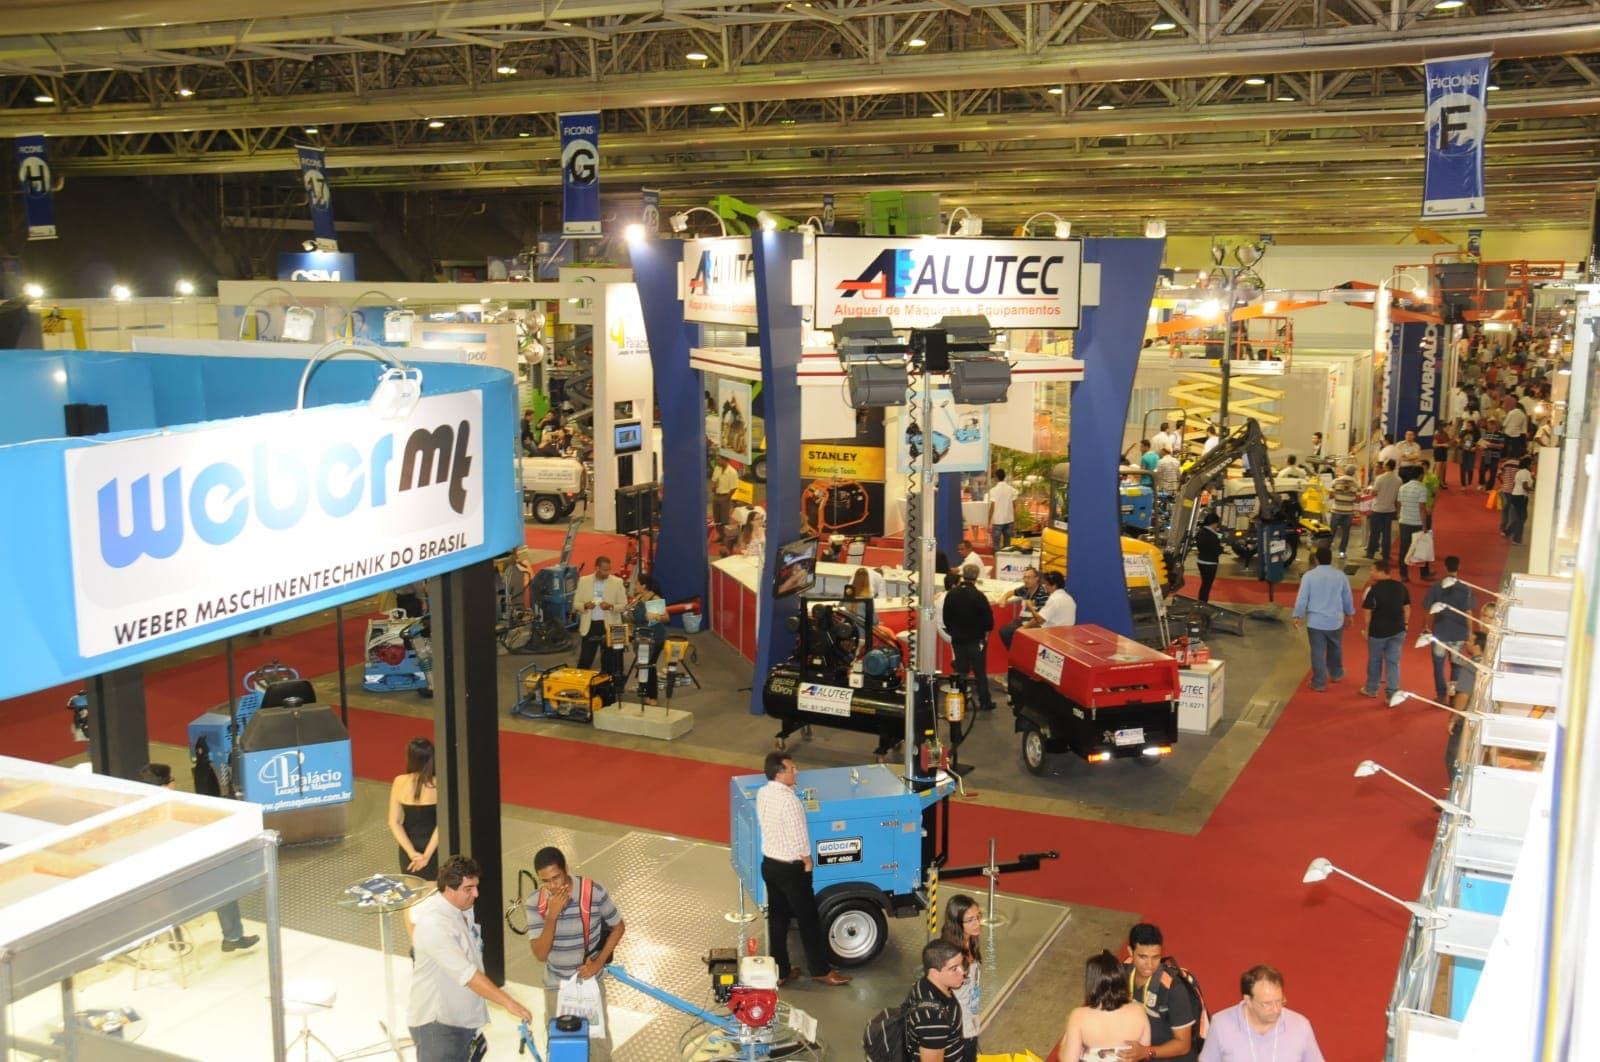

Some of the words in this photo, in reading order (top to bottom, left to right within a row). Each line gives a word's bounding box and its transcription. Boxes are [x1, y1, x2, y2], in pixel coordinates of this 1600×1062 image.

[1430, 74, 1480, 90] FICONS
[564, 126, 593, 136] FICONS
[1440, 105, 1471, 150] F
[571, 149, 595, 183] G
[912, 255, 1064, 294] ALUTEC
[834, 304, 884, 317] Aluguel
[886, 304, 900, 316] de
[977, 304, 1061, 317] Equipamentos
[808, 450, 857, 461] STANLEY
[97, 433, 394, 569] weber
[115, 604, 188, 645] WEBER
[195, 553, 386, 624] MASCHINENTECHNIK
[390, 548, 414, 570] DO
[419, 532, 468, 562] BRASIL
[816, 686, 852, 700] ALUTEC
[290, 769, 342, 785] Palácio
